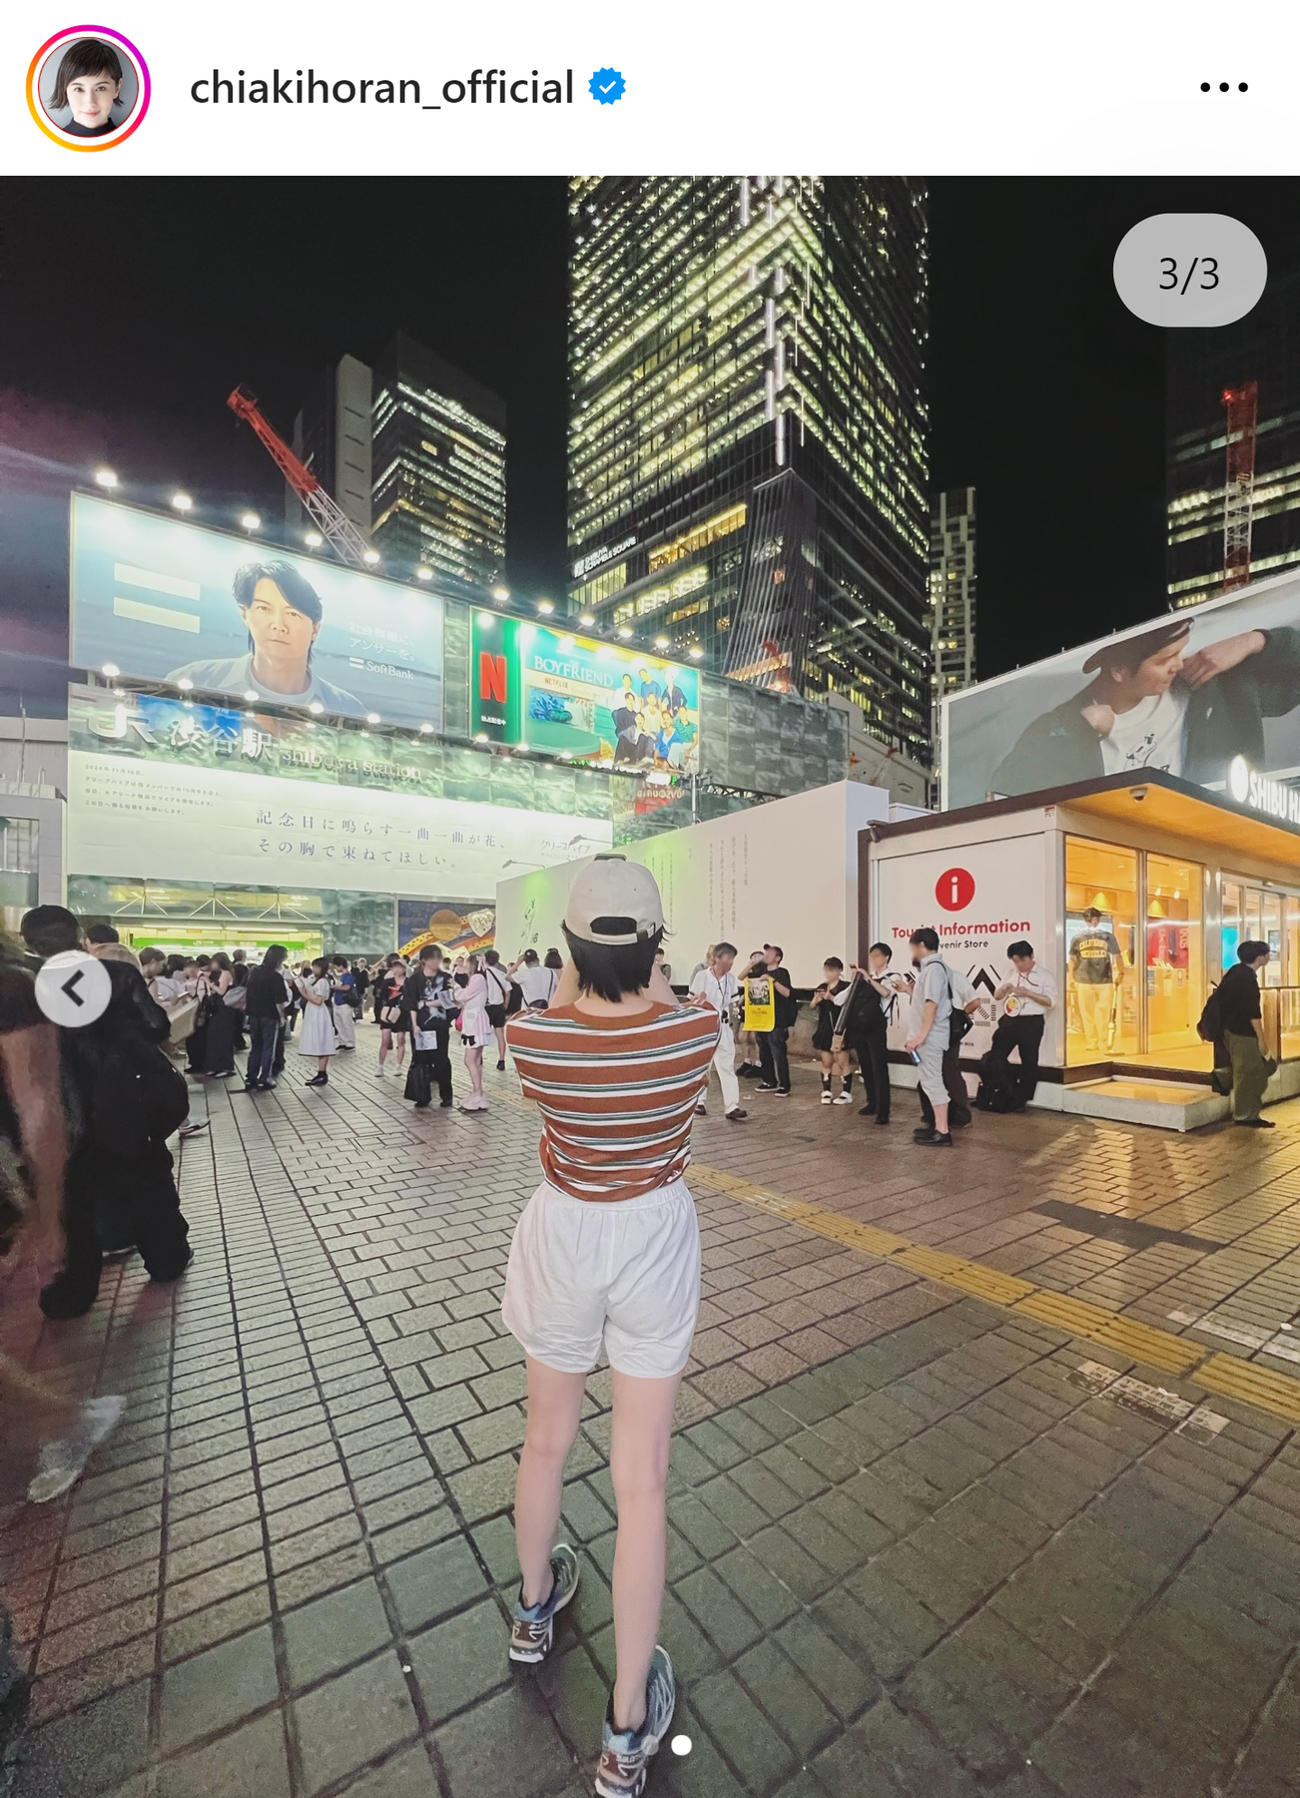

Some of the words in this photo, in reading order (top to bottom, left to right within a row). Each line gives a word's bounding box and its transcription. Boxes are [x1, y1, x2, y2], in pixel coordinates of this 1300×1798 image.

[366, 660, 414, 680] SoftBank
[534, 656, 614, 687] BOYFRIEND
[168, 716, 272, 758] 渋谷駅
[1249, 770, 1288, 819] SHIBU
[940, 919, 1031, 936] Information
[964, 940, 989, 949] Store
